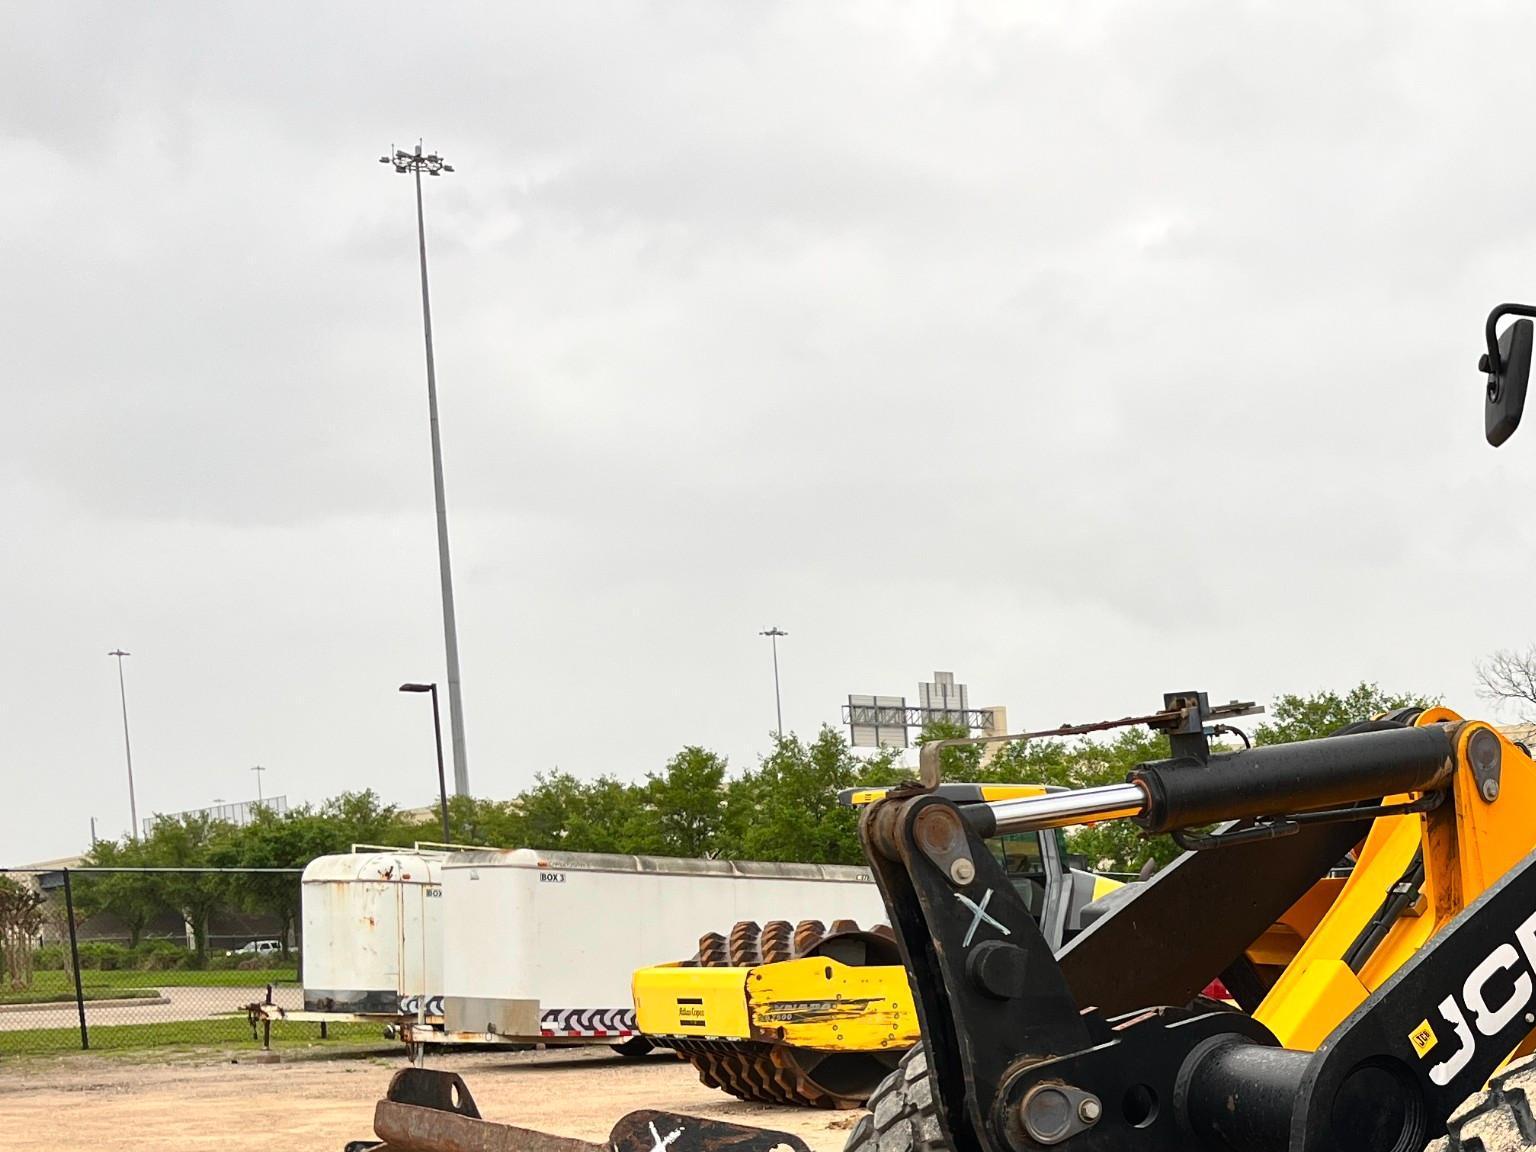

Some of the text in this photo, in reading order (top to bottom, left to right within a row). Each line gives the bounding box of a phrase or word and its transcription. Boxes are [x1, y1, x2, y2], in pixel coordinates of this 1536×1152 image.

[541, 873, 565, 882] BOX 3
[1416, 1030, 1430, 1047] JCB
